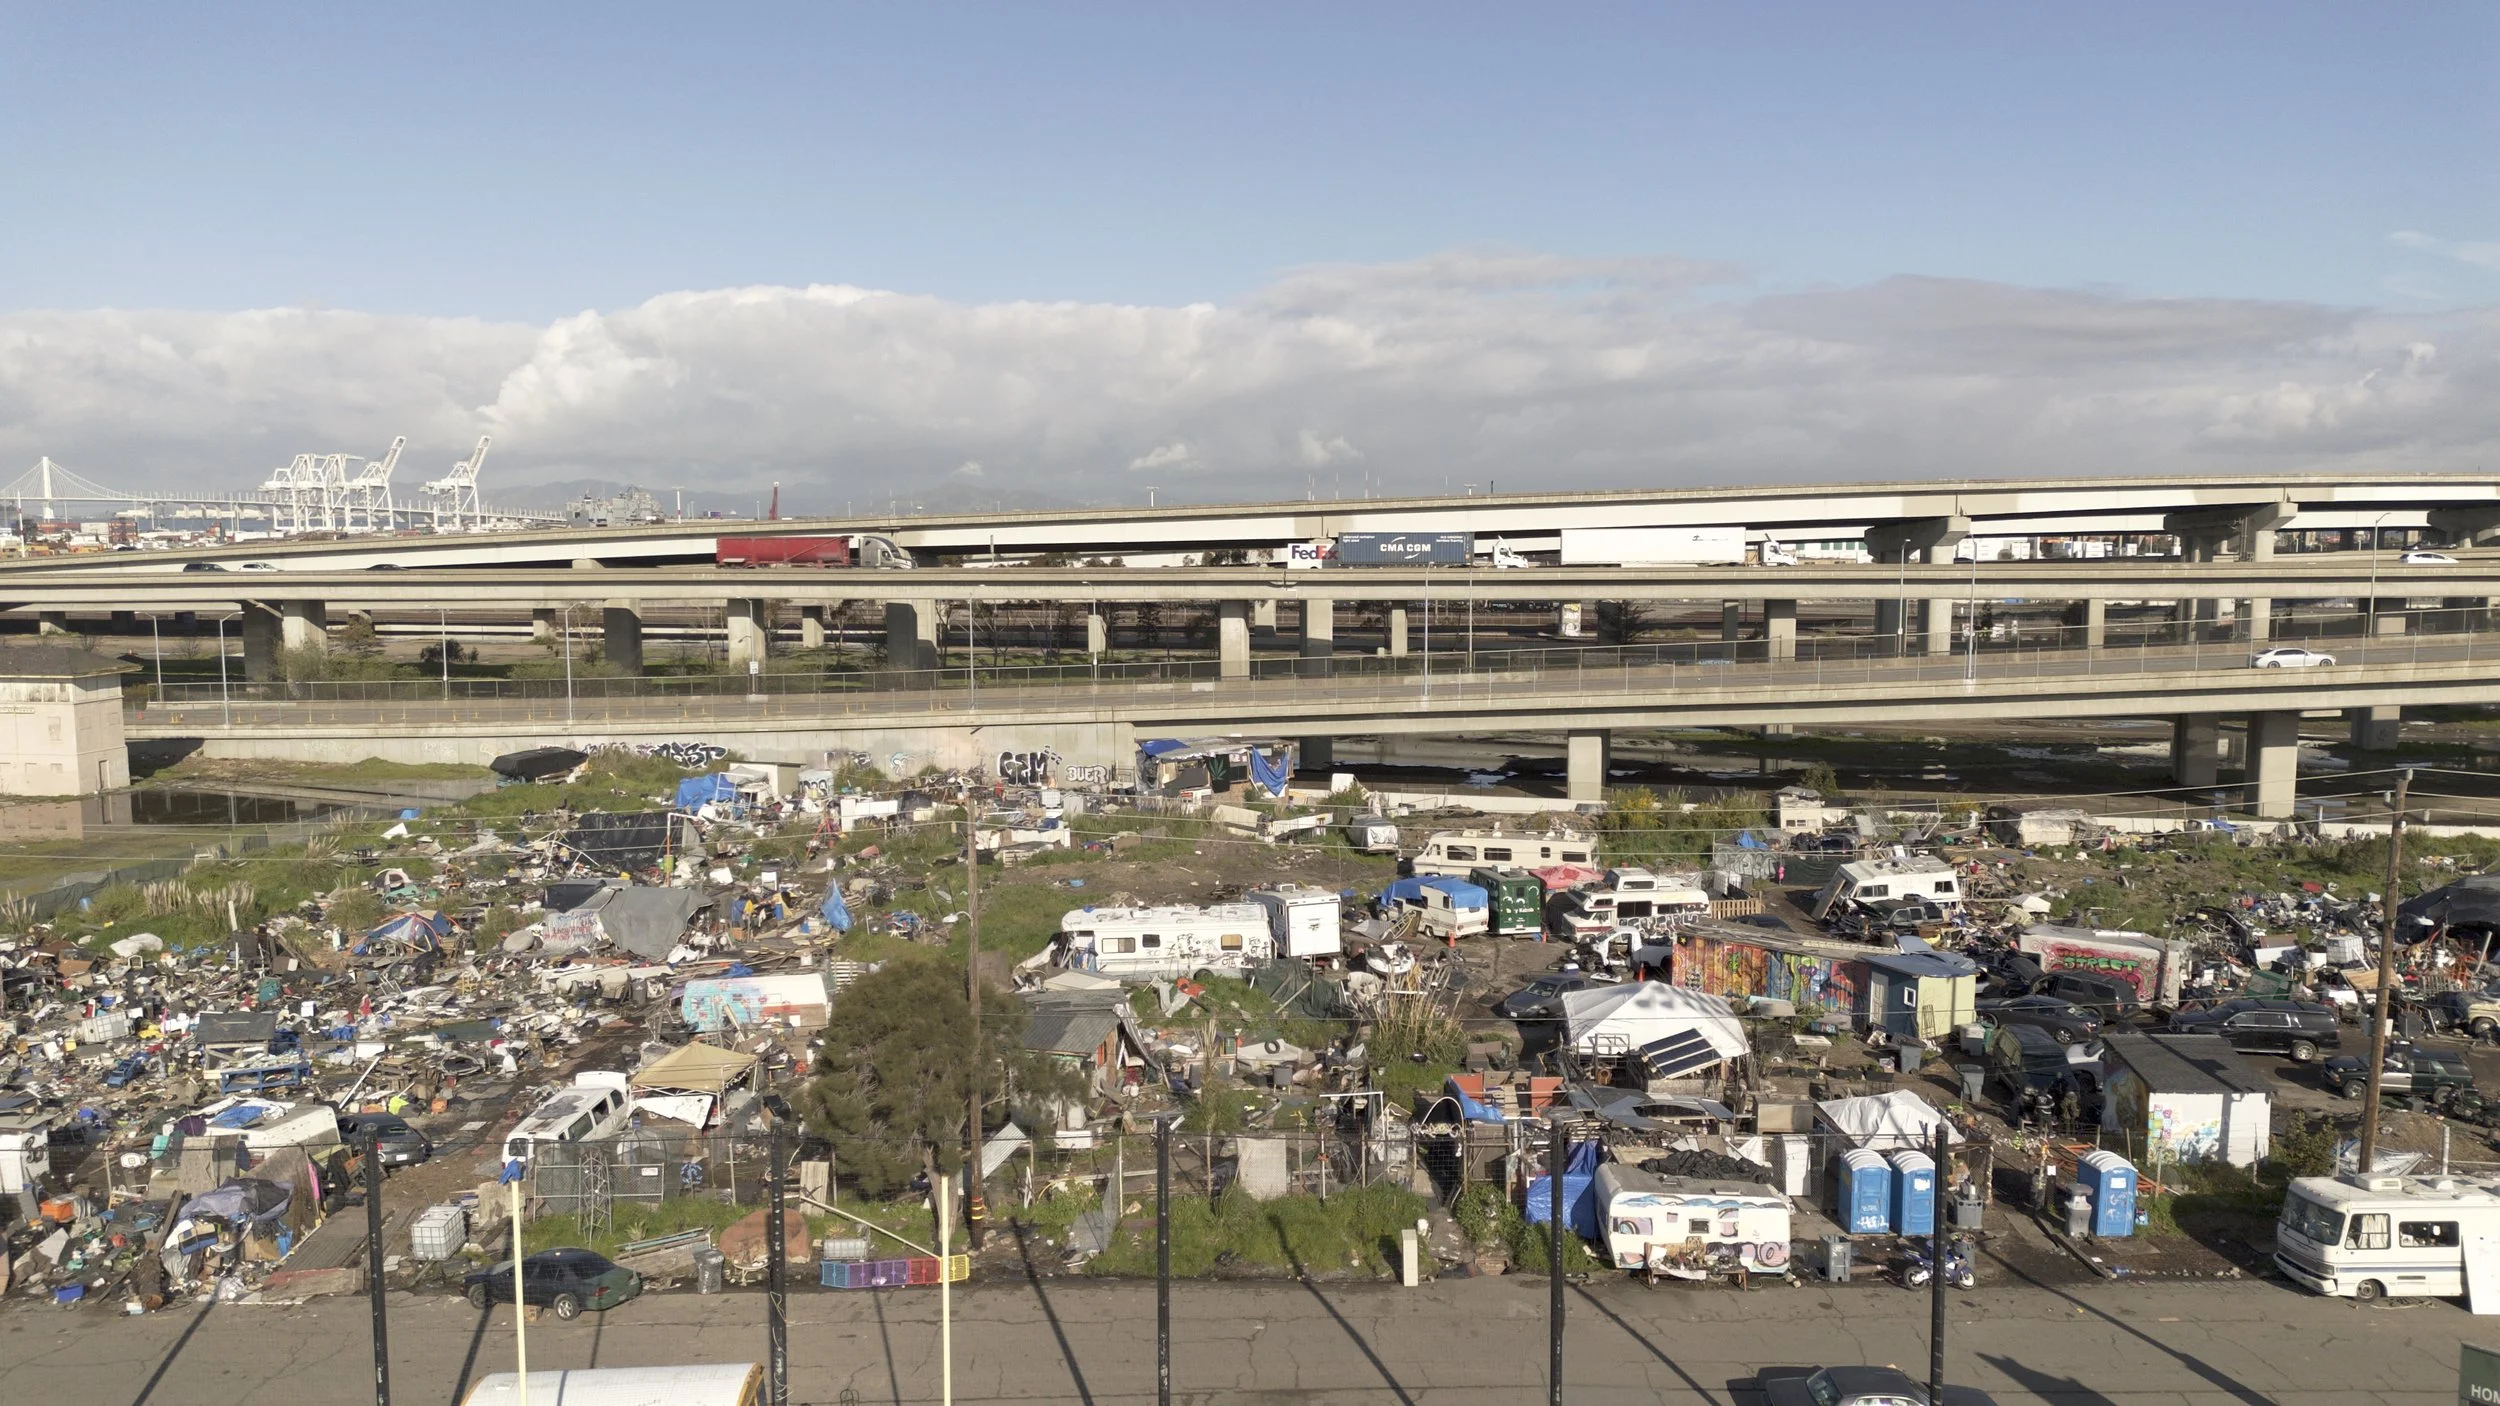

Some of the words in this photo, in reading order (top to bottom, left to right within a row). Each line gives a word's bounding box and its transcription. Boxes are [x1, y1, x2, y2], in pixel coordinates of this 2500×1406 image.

[1291, 544, 1338, 560] FedEx
[1379, 543, 1404, 552] CMA
[1406, 543, 1432, 552] CGM
[2063, 957, 2139, 971] STREET
